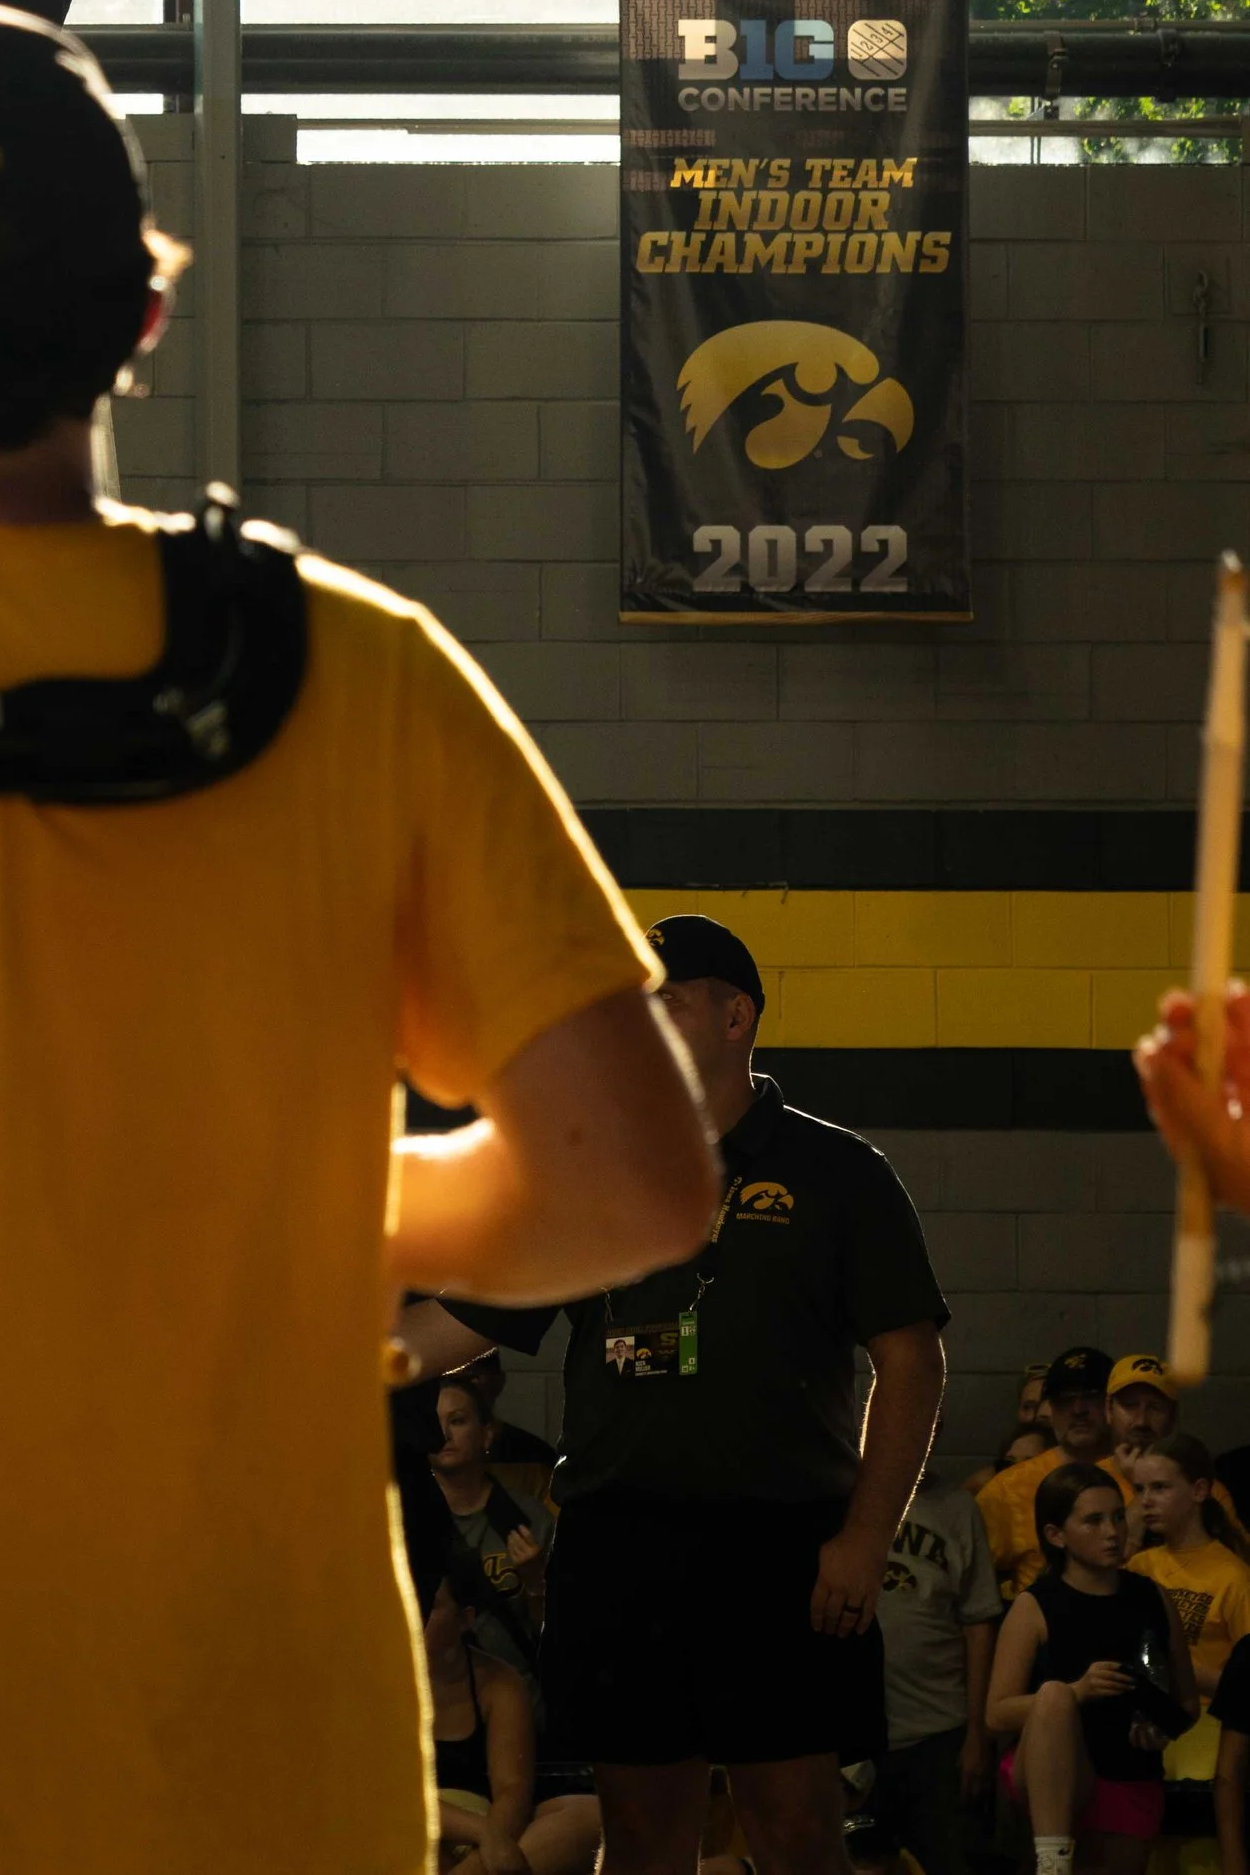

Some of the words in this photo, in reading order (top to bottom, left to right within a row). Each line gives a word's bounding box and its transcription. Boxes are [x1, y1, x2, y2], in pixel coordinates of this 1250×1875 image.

[678, 87, 907, 112] CONFERENCE
[670, 158, 791, 188] MEN'S
[805, 158, 917, 188] TEAM
[694, 190, 891, 230] INDOOR
[636, 231, 951, 273] CHAMPIONS
[693, 525, 907, 592] 2022
[736, 1212, 772, 1222] MARCHING
